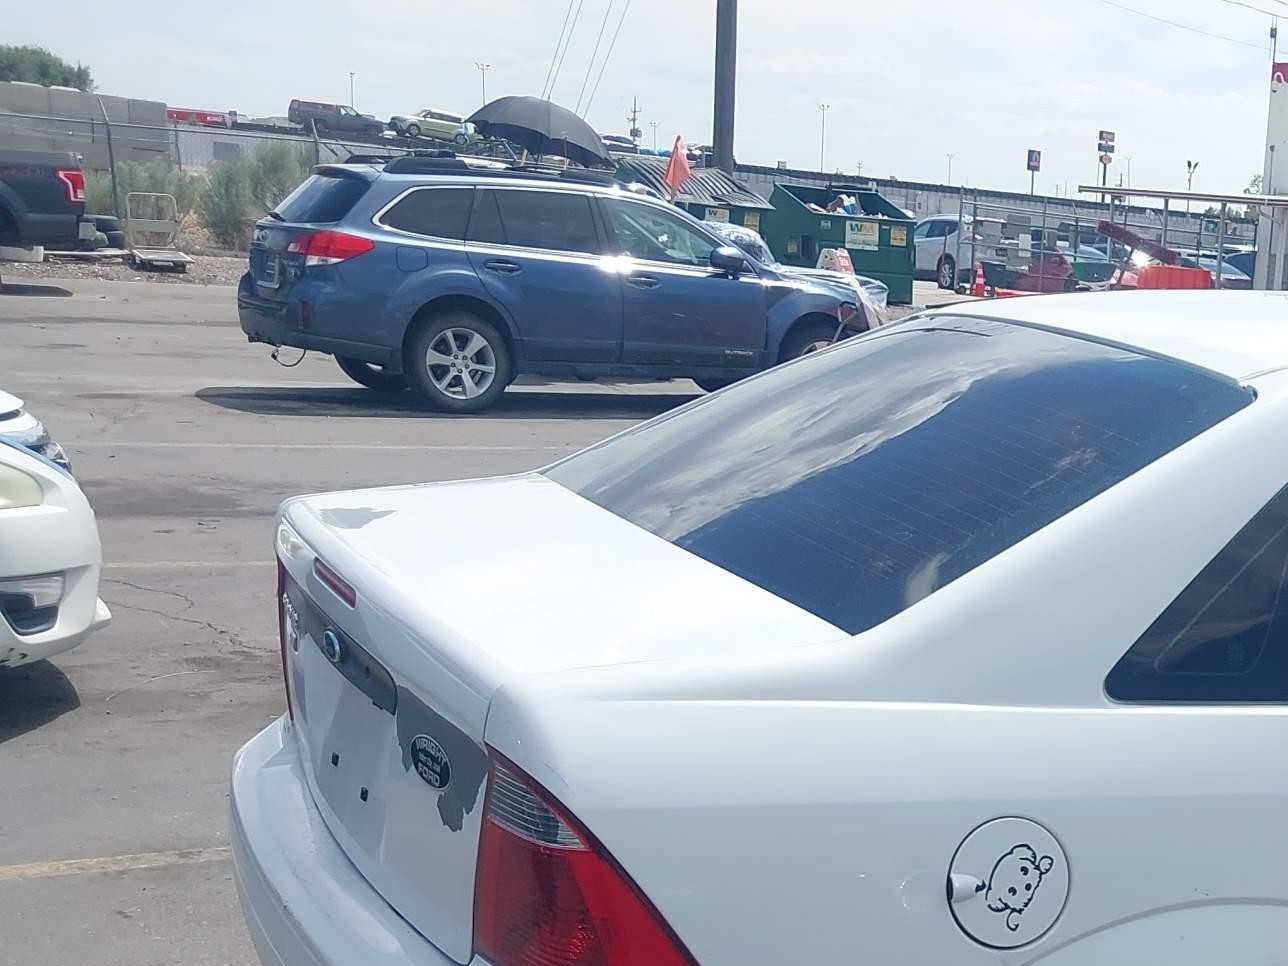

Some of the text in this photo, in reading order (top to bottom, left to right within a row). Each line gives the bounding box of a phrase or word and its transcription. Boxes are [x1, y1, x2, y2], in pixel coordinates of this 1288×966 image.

[849, 223, 875, 234] WM
[415, 738, 447, 767] WRIGHT
[418, 763, 441, 787] FORD
